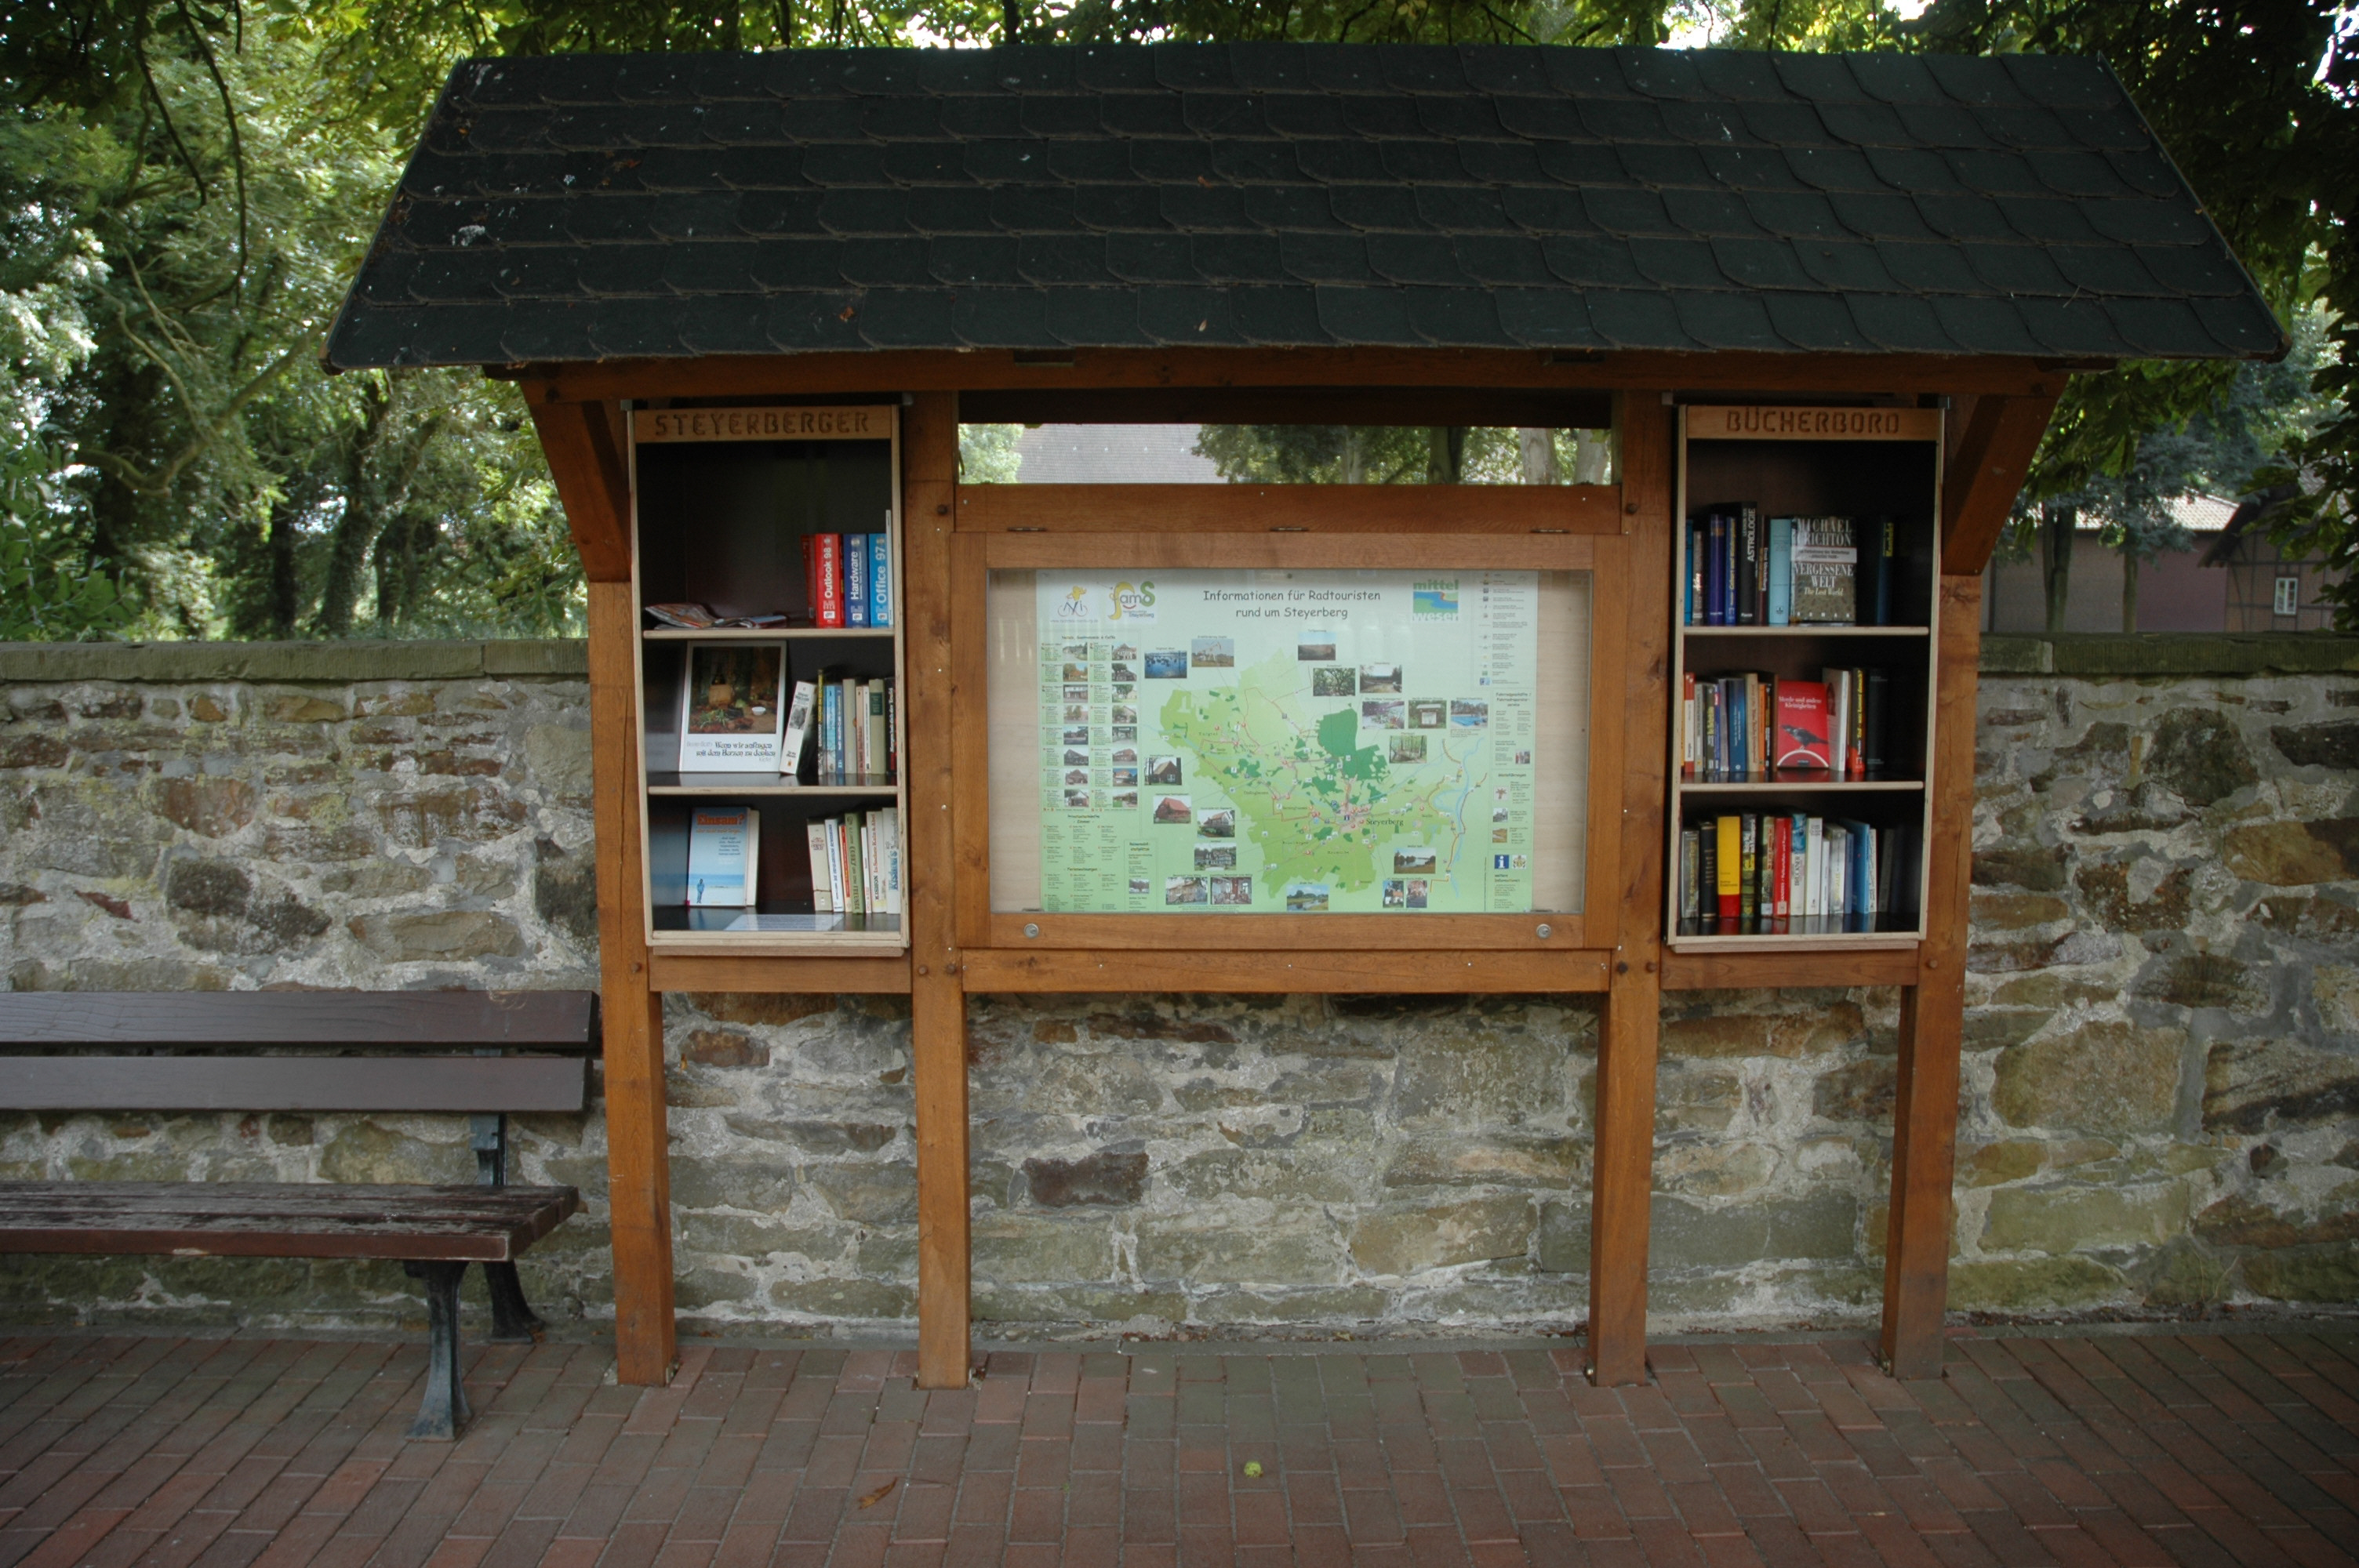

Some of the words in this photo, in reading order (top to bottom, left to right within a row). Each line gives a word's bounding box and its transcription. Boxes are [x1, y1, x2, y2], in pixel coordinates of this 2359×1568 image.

[655, 412, 869, 436] STEYERBERGER
[1726, 407, 1899, 434] BÜCHERBORD
[1797, 518, 1852, 532] MICHAEL
[823, 547, 832, 559] 98
[875, 546, 885, 561] 97
[850, 551, 859, 600] Hardware
[1794, 563, 1853, 576] VERGESSENE
[823, 561, 833, 598] Outlook
[876, 566, 886, 604] Office
[1413, 579, 1459, 590] mittel
[1811, 575, 1837, 588] WELT
[1203, 590, 1284, 601] Informationen
[1287, 590, 1306, 601] für
[1309, 590, 1381, 601] Radtouristen
[1236, 607, 1261, 617] rund
[1284, 607, 1348, 619] Steyerberg
[1412, 612, 1459, 622] weser
[1366, 818, 1404, 826] Steyerberg
